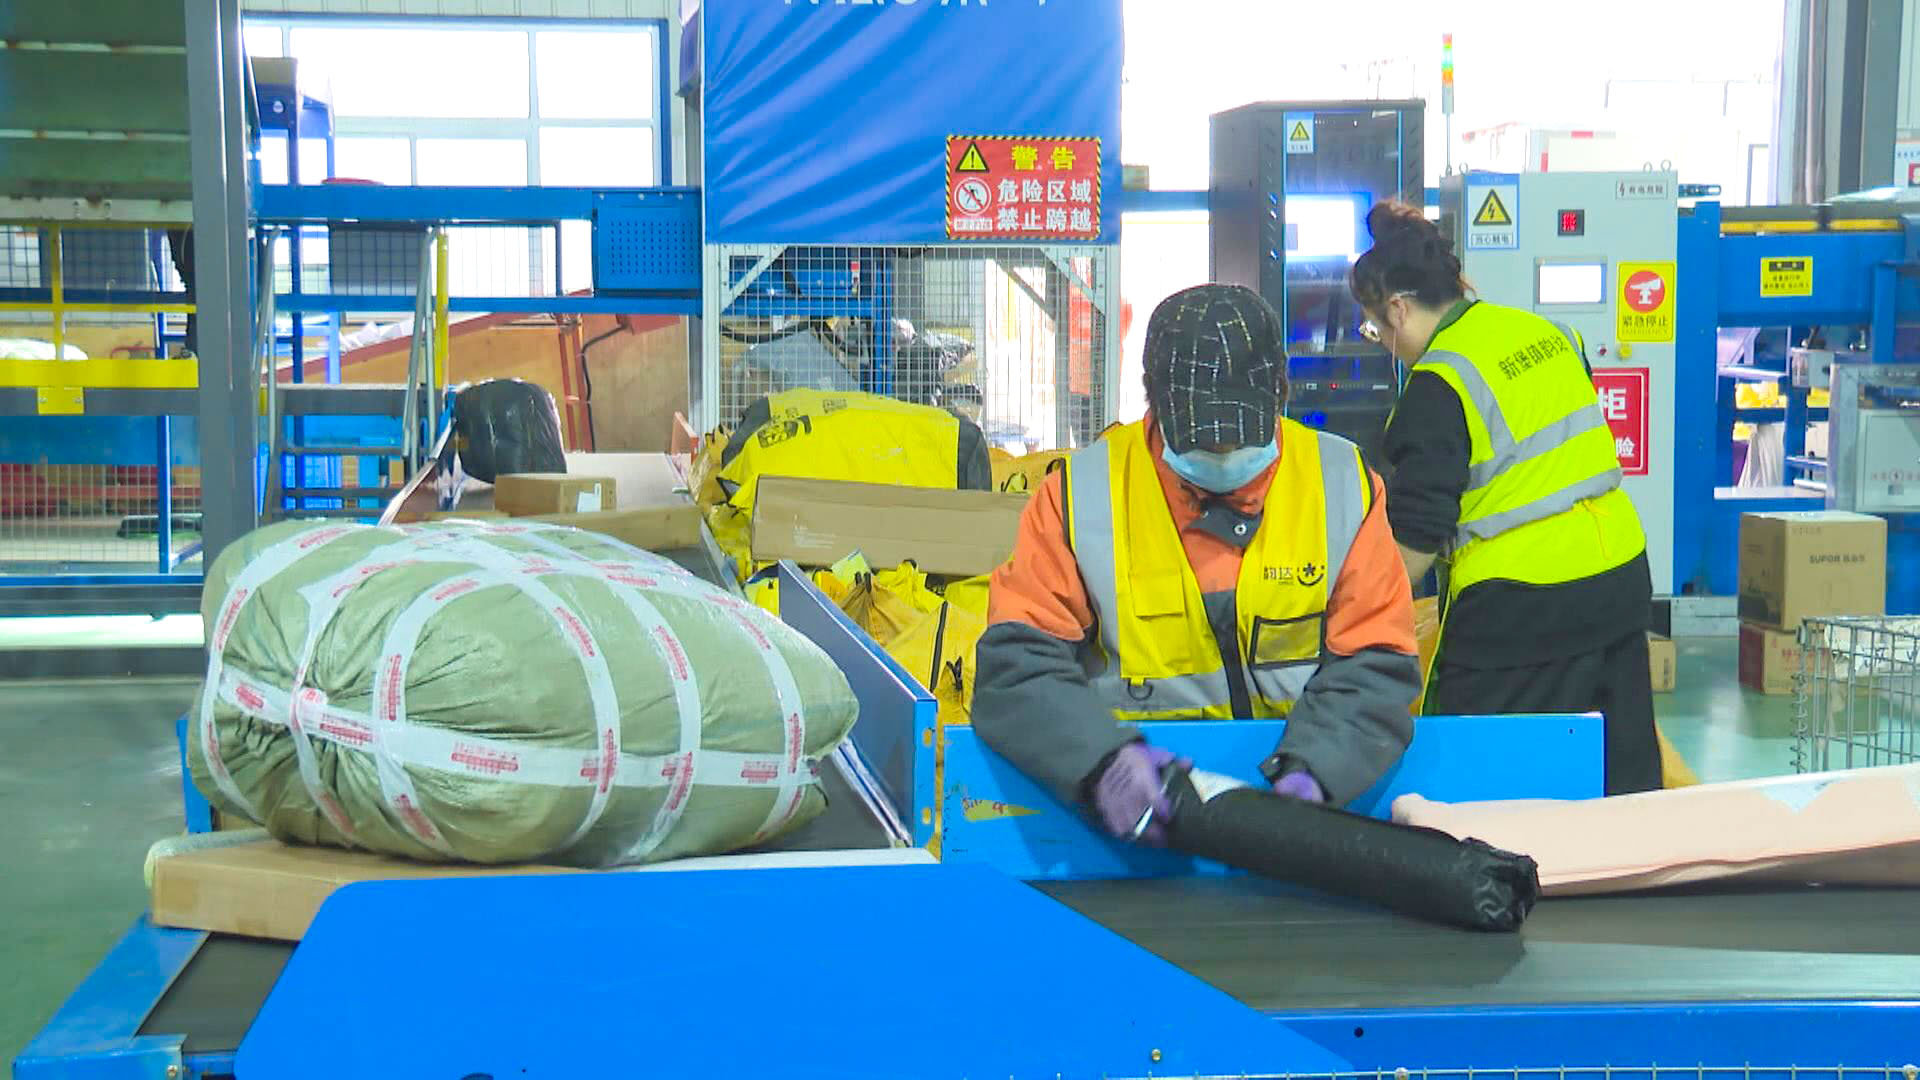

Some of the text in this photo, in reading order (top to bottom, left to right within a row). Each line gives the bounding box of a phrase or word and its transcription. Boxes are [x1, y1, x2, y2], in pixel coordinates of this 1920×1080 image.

[1012, 145, 1076, 171] 警告
[997, 179, 1092, 204] 危险区域
[996, 207, 1092, 233] 禁止跨越
[1622, 314, 1667, 329] 紧急停止
[1597, 387, 1628, 420] 柜
[1809, 555, 1841, 565] SUPOR
